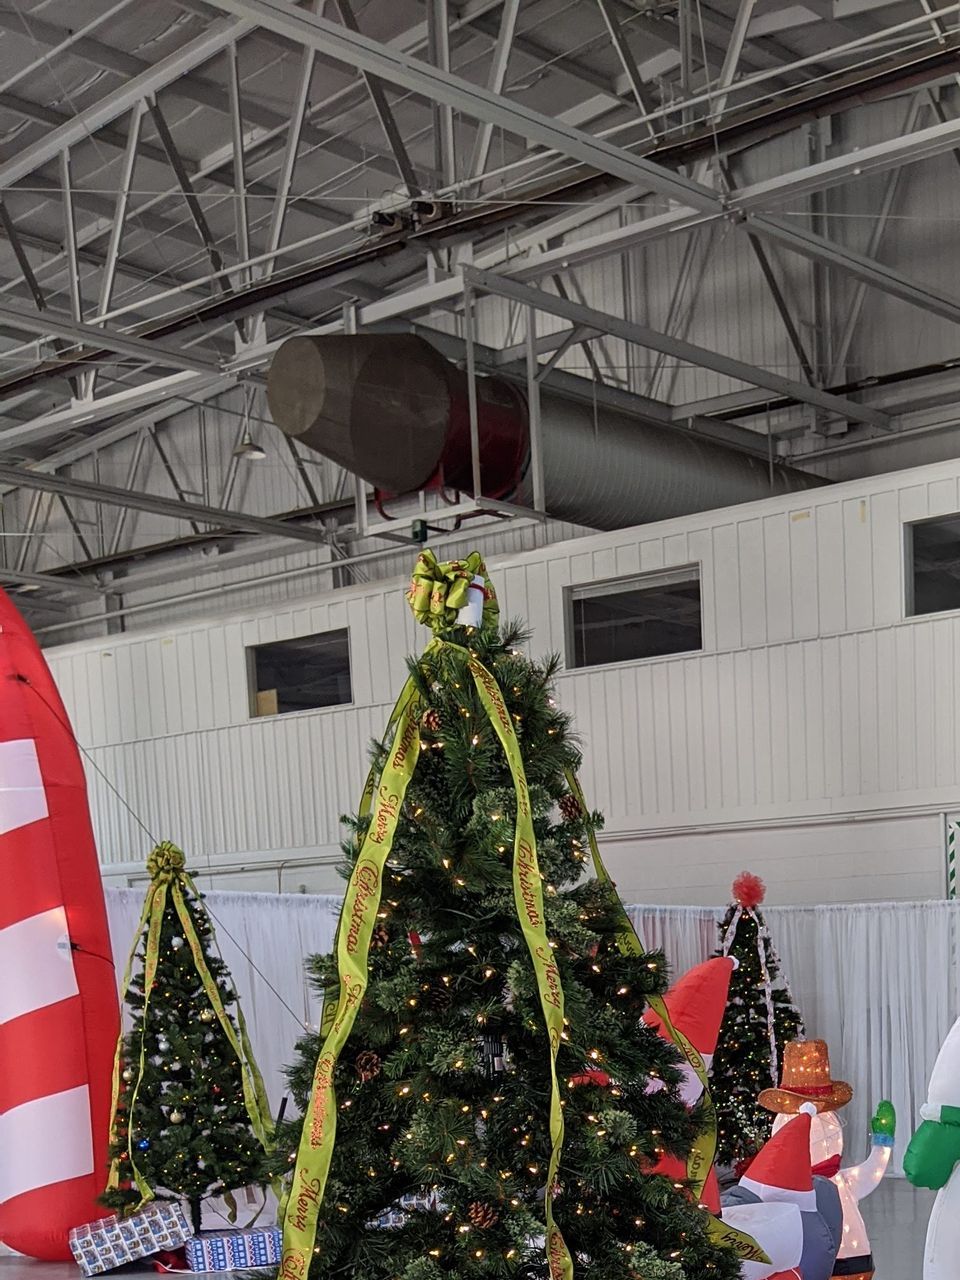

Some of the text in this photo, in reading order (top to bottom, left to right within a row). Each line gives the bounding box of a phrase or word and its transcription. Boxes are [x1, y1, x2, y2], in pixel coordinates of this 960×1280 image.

[368, 786, 399, 845] Merry
[345, 858, 380, 954] Christmas
[517, 838, 543, 928] Christmas
[535, 946, 561, 1009] Merry
[287, 1167, 321, 1233] Merry
[720, 1231, 765, 1262] Merry
